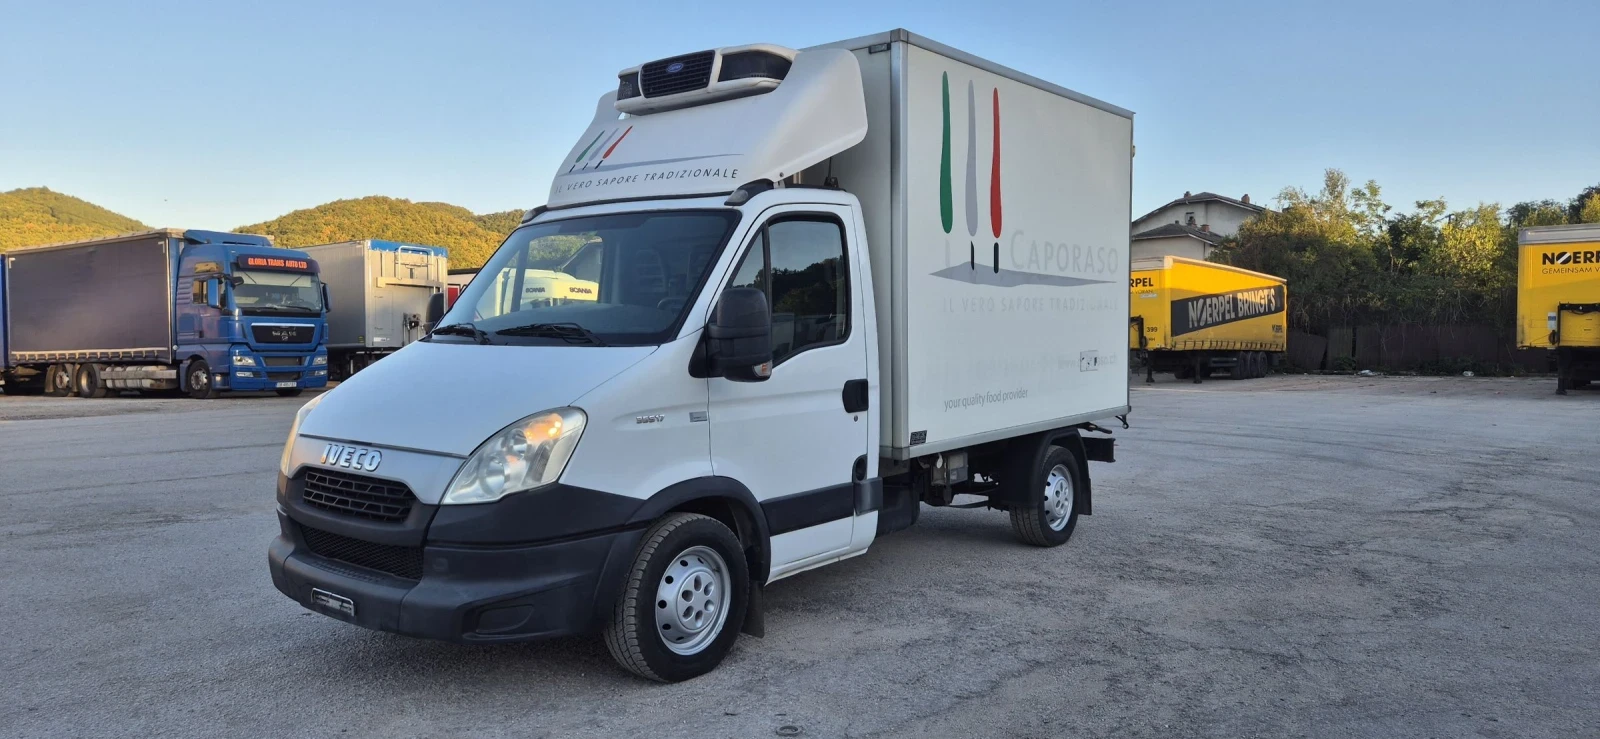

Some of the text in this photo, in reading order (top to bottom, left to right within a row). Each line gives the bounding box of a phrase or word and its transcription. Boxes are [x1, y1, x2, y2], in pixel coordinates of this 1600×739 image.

[555, 168, 739, 195] IL VERO SAPORE TRADIZIONALE
[248, 257, 308, 269] GLORIA TRANS AUTO LTD
[1542, 266, 1592, 275] GEMEINSAM
[943, 297, 955, 313] IL
[961, 296, 996, 313] VERO
[1000, 296, 1045, 313] SAPORE
[1188, 288, 1276, 328] NOERPEL BRINGT'S
[943, 387, 1029, 412] your quality food provider
[320, 443, 383, 472] IVECO
